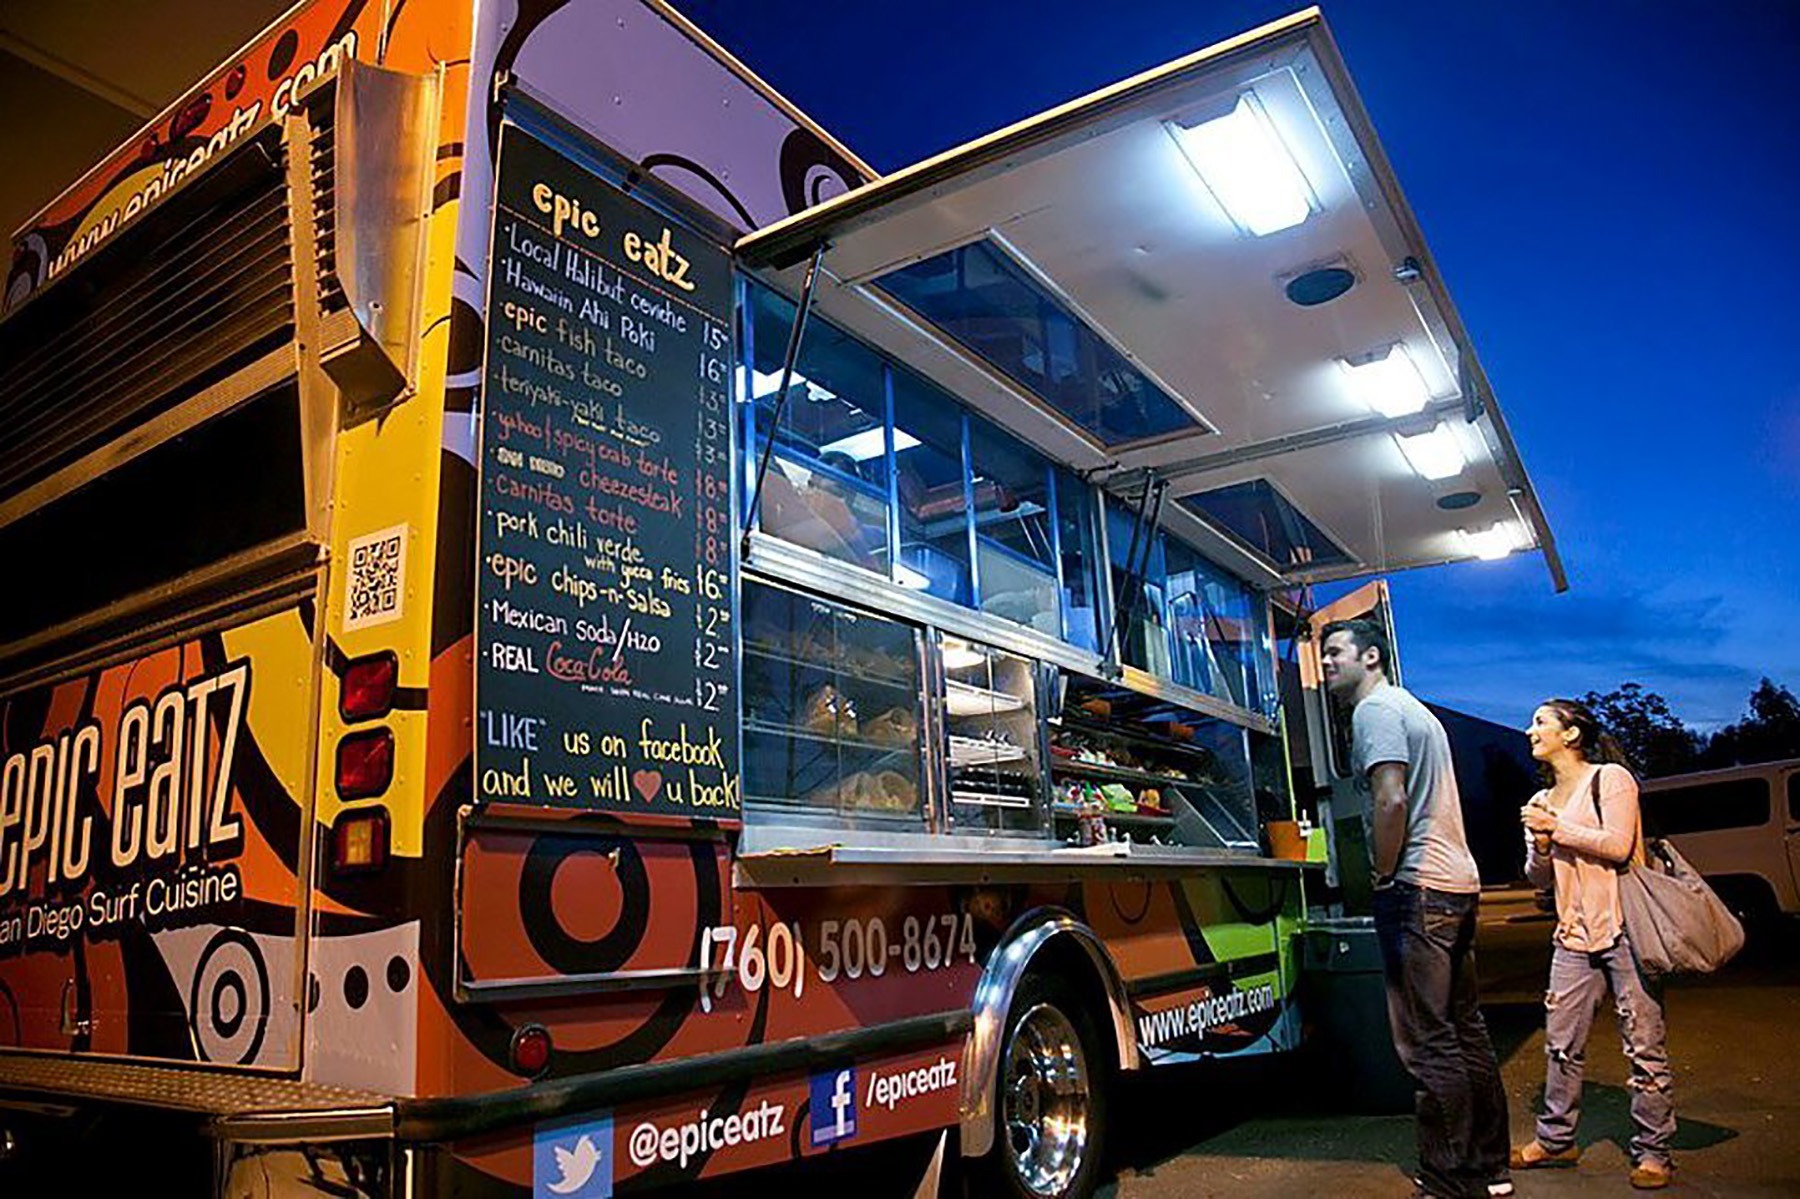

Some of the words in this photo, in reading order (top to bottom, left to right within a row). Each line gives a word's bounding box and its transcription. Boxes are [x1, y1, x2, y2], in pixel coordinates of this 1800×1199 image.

[532, 183, 600, 238] epic
[623, 228, 695, 291] eatz
[510, 222, 560, 271] Local
[565, 248, 626, 304] Halibut
[504, 302, 547, 332] epic
[556, 318, 596, 357] fish
[602, 337, 647, 379] taco
[579, 298, 609, 329] Ahi
[621, 315, 655, 353] Poki
[581, 361, 622, 396] taco
[615, 403, 661, 443] taco
[636, 448, 678, 485] torte
[585, 495, 637, 534] torte
[546, 517, 588, 549] chili
[597, 536, 645, 564] verde
[491, 553, 538, 591] epic
[583, 553, 616, 574] with
[661, 566, 691, 595] fries
[492, 599, 568, 635] Mexican
[492, 642, 540, 674] REAL
[563, 731, 590, 755] us
[601, 734, 627, 758] on
[638, 717, 724, 769] facebook
[483, 757, 531, 798] and
[543, 774, 578, 797] we
[590, 766, 631, 801] will
[667, 782, 683, 804] u
[689, 768, 740, 810] back!
[0, 917, 22, 944] an
[27, 903, 84, 940] Diego
[89, 882, 140, 926] Surf
[146, 870, 237, 916] Cuisine
[700, 921, 805, 1013] (760)
[818, 912, 976, 981] 500-8674
[1138, 983, 1275, 1047] www.epiceatz.com
[865, 1057, 957, 1107] /epiceatz
[629, 1100, 785, 1169] @epiceatz
